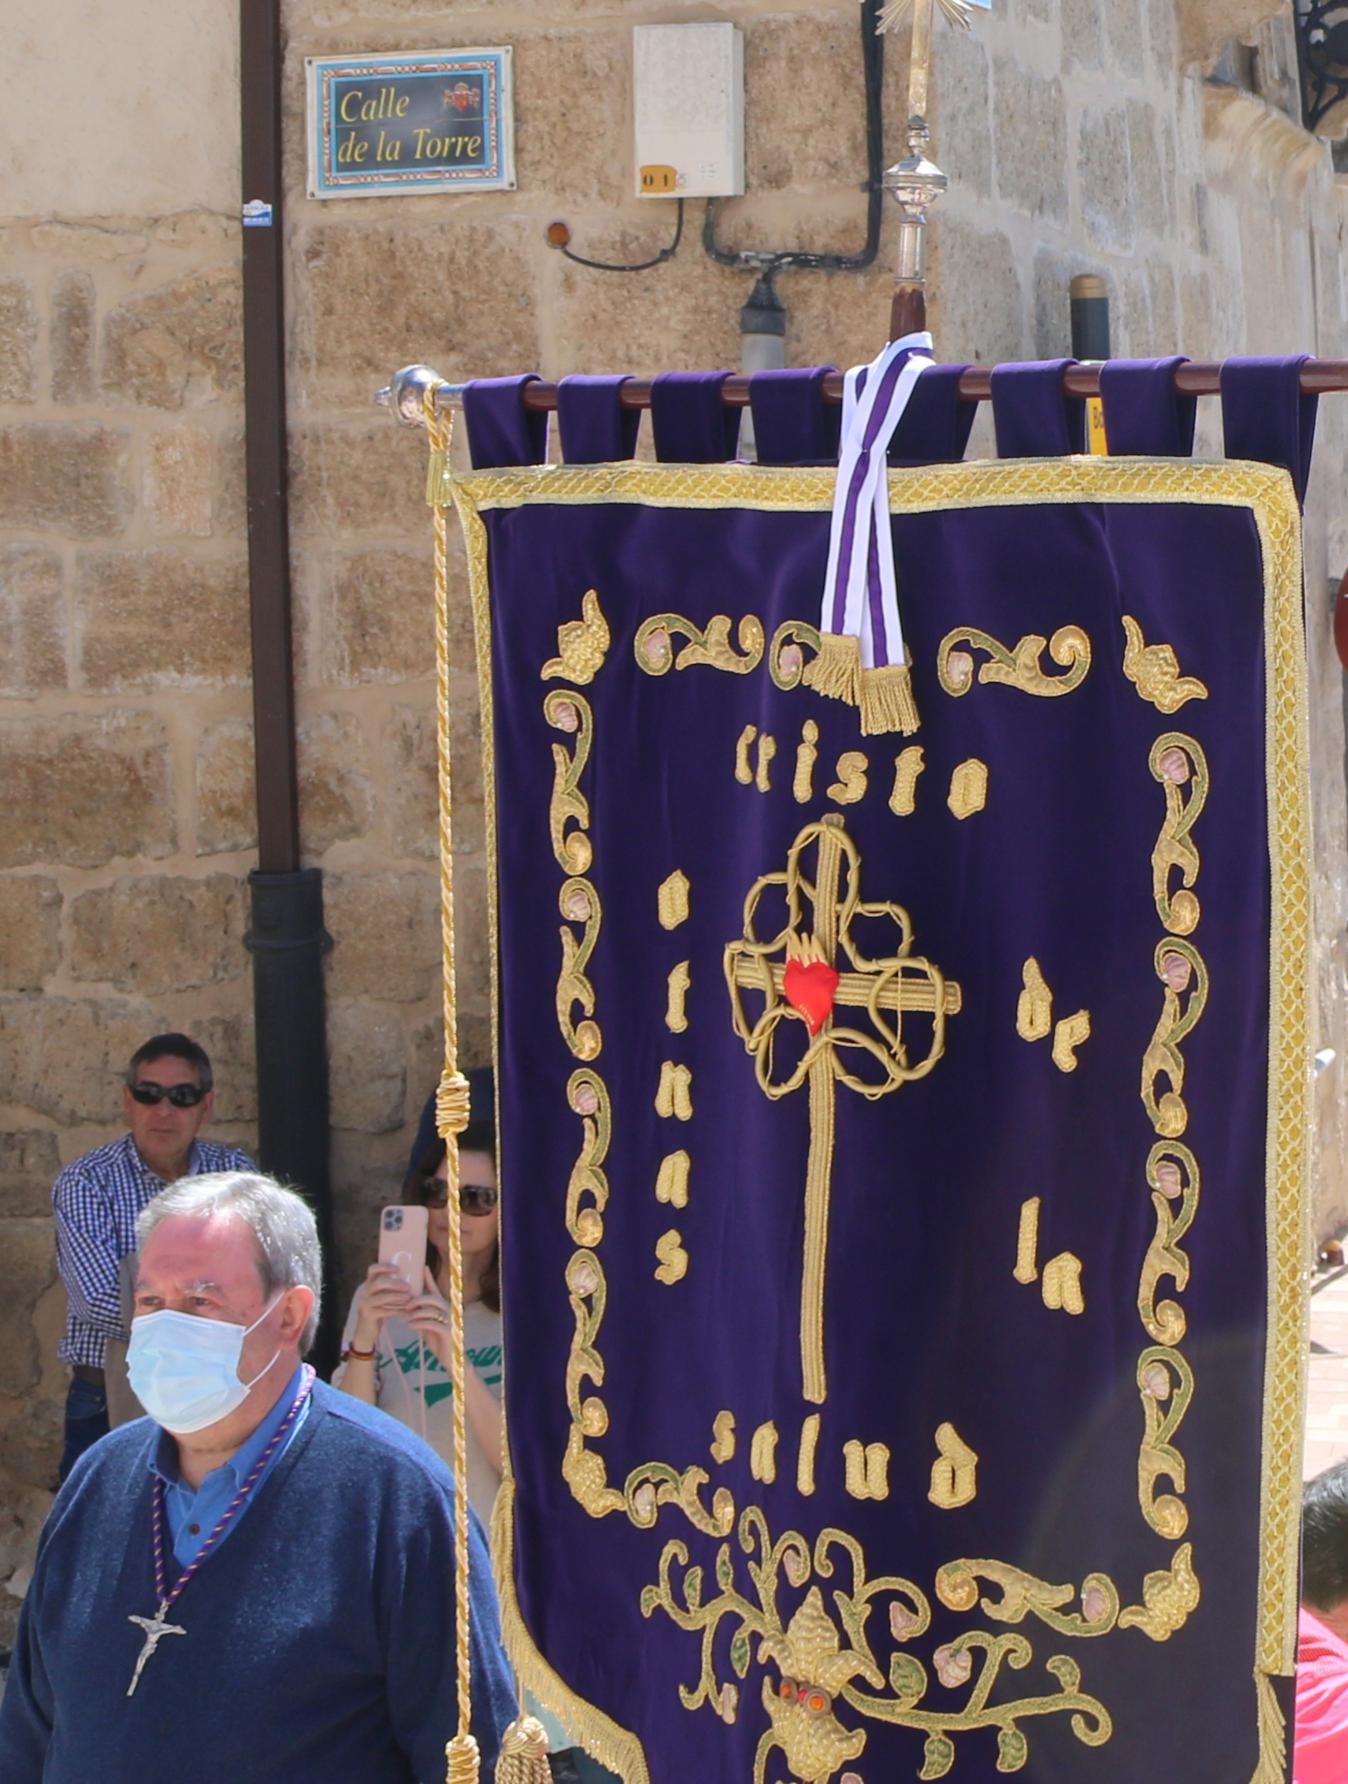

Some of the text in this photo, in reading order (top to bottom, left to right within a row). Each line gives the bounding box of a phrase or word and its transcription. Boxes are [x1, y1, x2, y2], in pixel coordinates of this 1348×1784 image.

[338, 128, 481, 162] de la Torre
[340, 87, 410, 122] Calle
[1016, 955, 1091, 1073] de
[1012, 1196, 1084, 1316] la
[709, 1409, 979, 1511] salud
